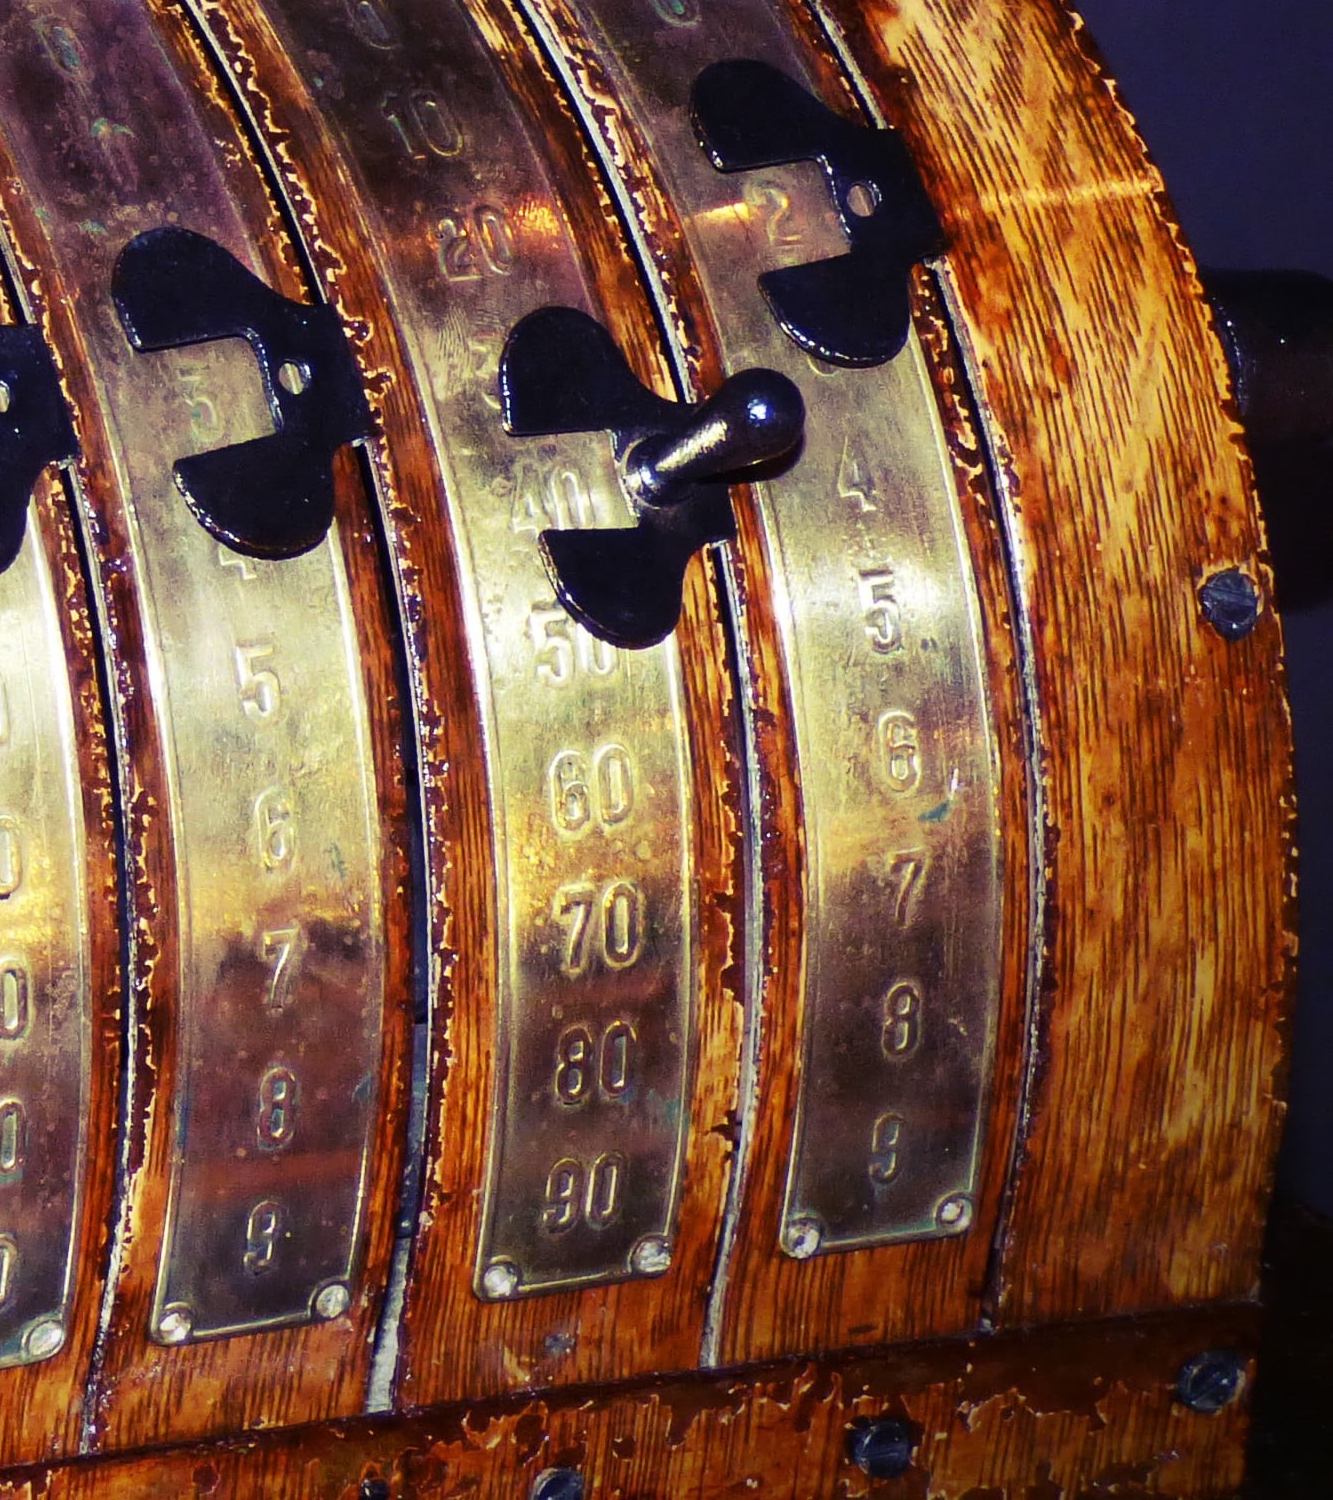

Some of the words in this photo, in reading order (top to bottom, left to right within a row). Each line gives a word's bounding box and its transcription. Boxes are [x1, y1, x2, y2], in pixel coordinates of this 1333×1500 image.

[383, 90, 465, 160] 10
[434, 203, 514, 283] 20
[743, 176, 805, 247] 2
[855, 567, 904, 655] 5
[232, 642, 283, 723] 5
[548, 741, 636, 836] 60
[876, 708, 924, 795] 6
[250, 787, 300, 873] 6
[553, 880, 645, 979] 70
[886, 845, 930, 930] 7
[259, 926, 302, 1016] 7
[552, 1019, 641, 1106] 80
[879, 980, 926, 1063] 8
[256, 1065, 300, 1150] 8
[541, 1149, 628, 1234] 90
[242, 1199, 282, 1277] 9
